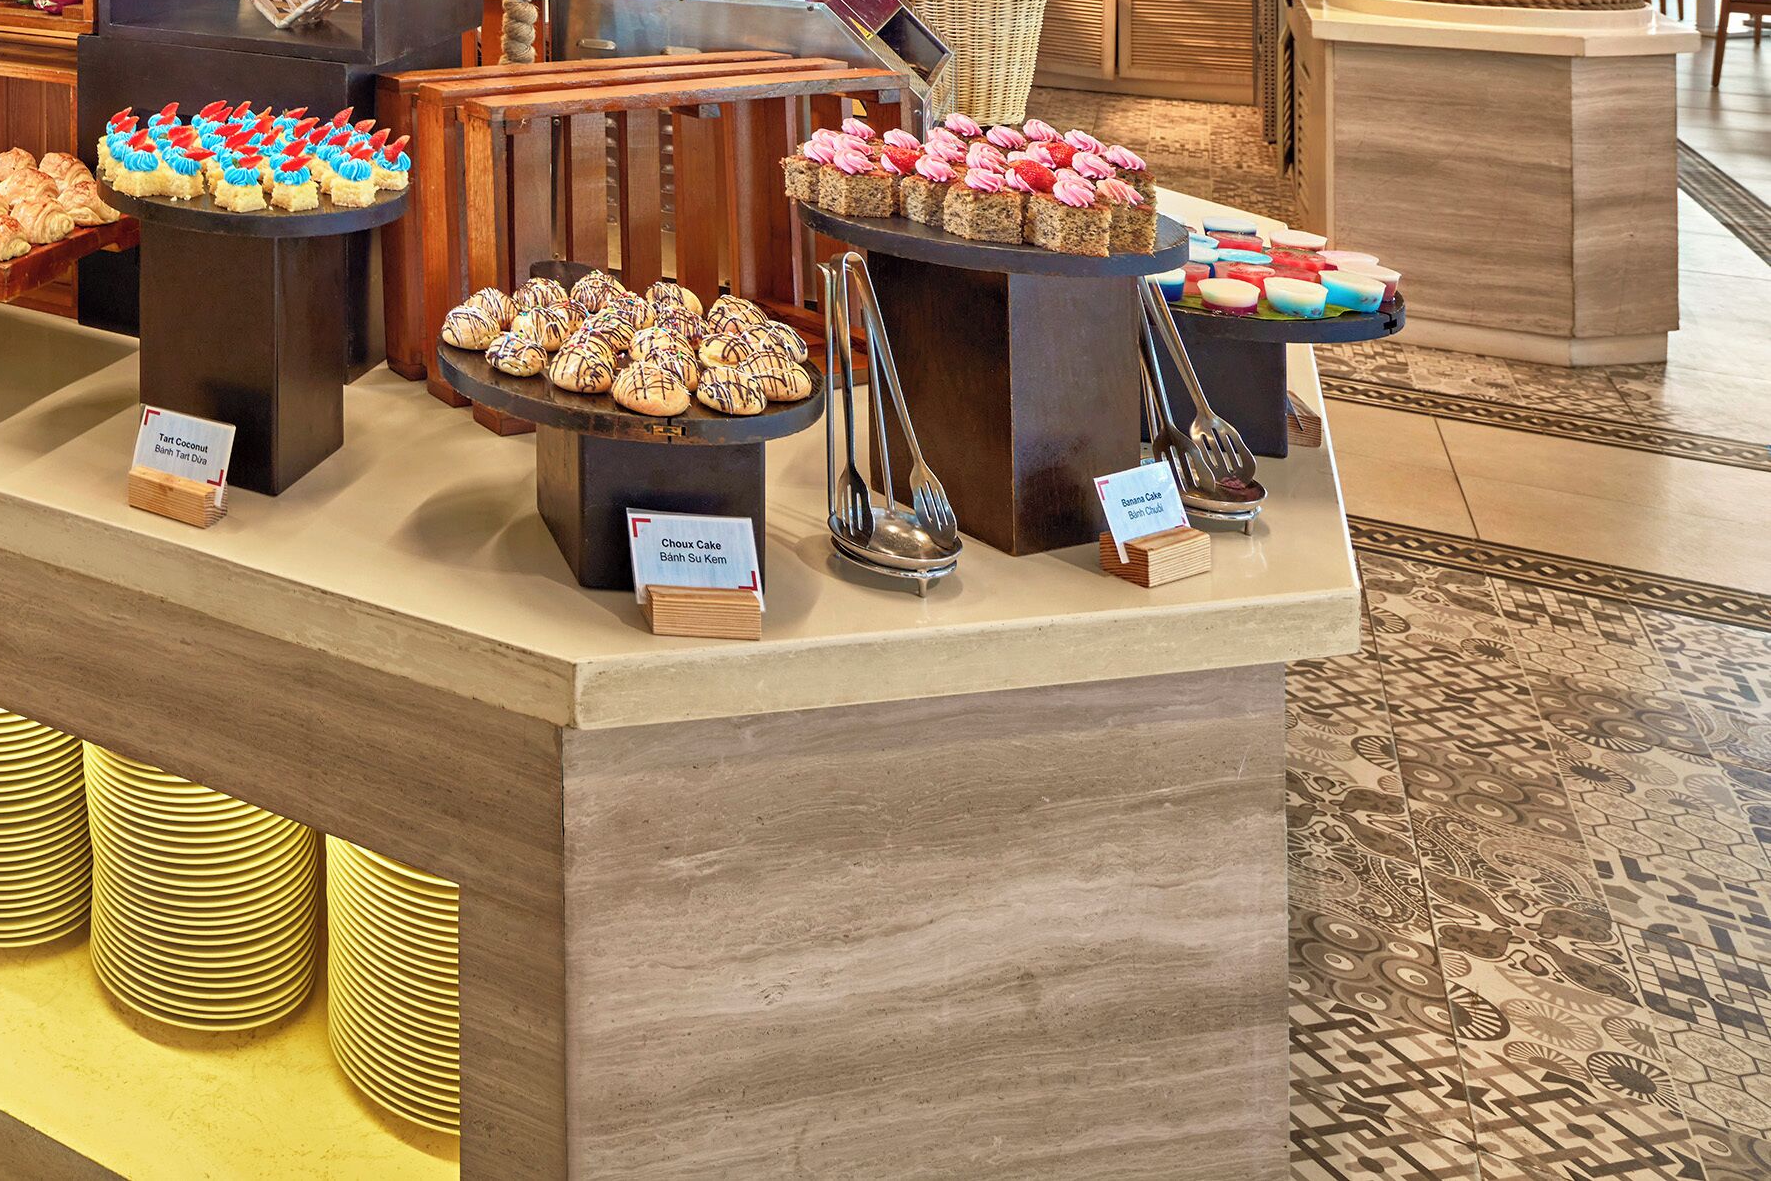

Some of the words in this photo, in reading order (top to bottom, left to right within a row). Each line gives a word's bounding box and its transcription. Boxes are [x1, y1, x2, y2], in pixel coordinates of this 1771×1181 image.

[159, 432, 174, 444] Tart
[175, 437, 208, 454] Coconut
[154, 444, 174, 456] Bánh
[175, 450, 190, 461] Tart
[1121, 496, 1145, 508] Banana
[1145, 491, 1162, 502] Cake
[1128, 509, 1145, 520] Bánh
[661, 538, 694, 549] Choux
[696, 540, 722, 550] Cake
[660, 551, 686, 563] Bánh
[688, 553, 702, 563] Su
[704, 554, 727, 565] Kem
